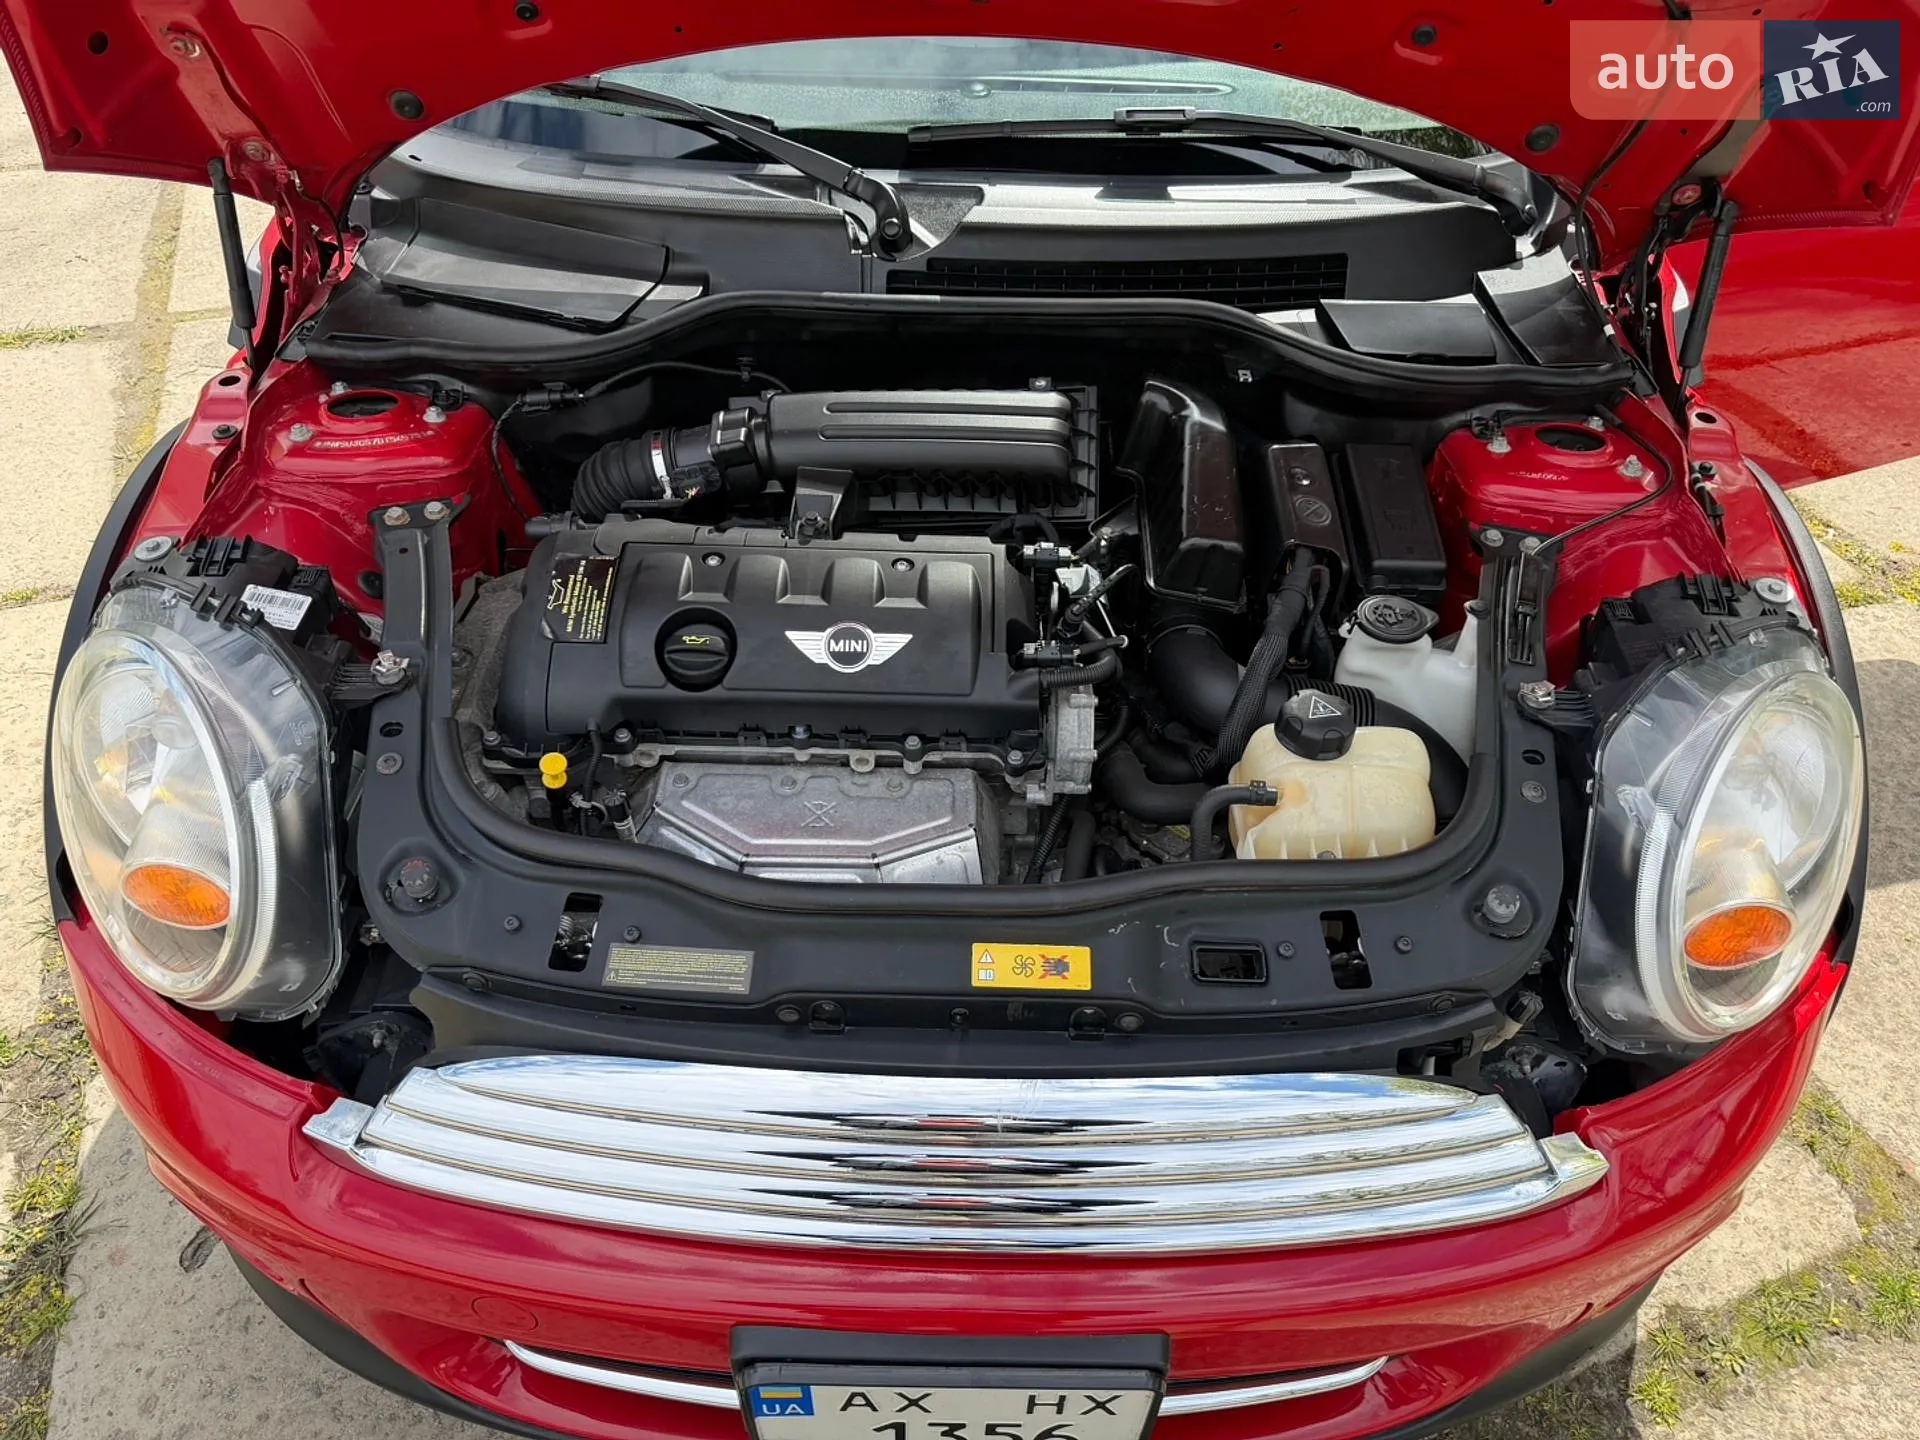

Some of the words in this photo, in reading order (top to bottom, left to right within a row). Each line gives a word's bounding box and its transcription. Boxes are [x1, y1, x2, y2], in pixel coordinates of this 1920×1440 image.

[829, 639, 867, 653] MINI
[762, 1403, 805, 1415] UA
[839, 1391, 932, 1414] AX
[1026, 1394, 1123, 1416] HX
